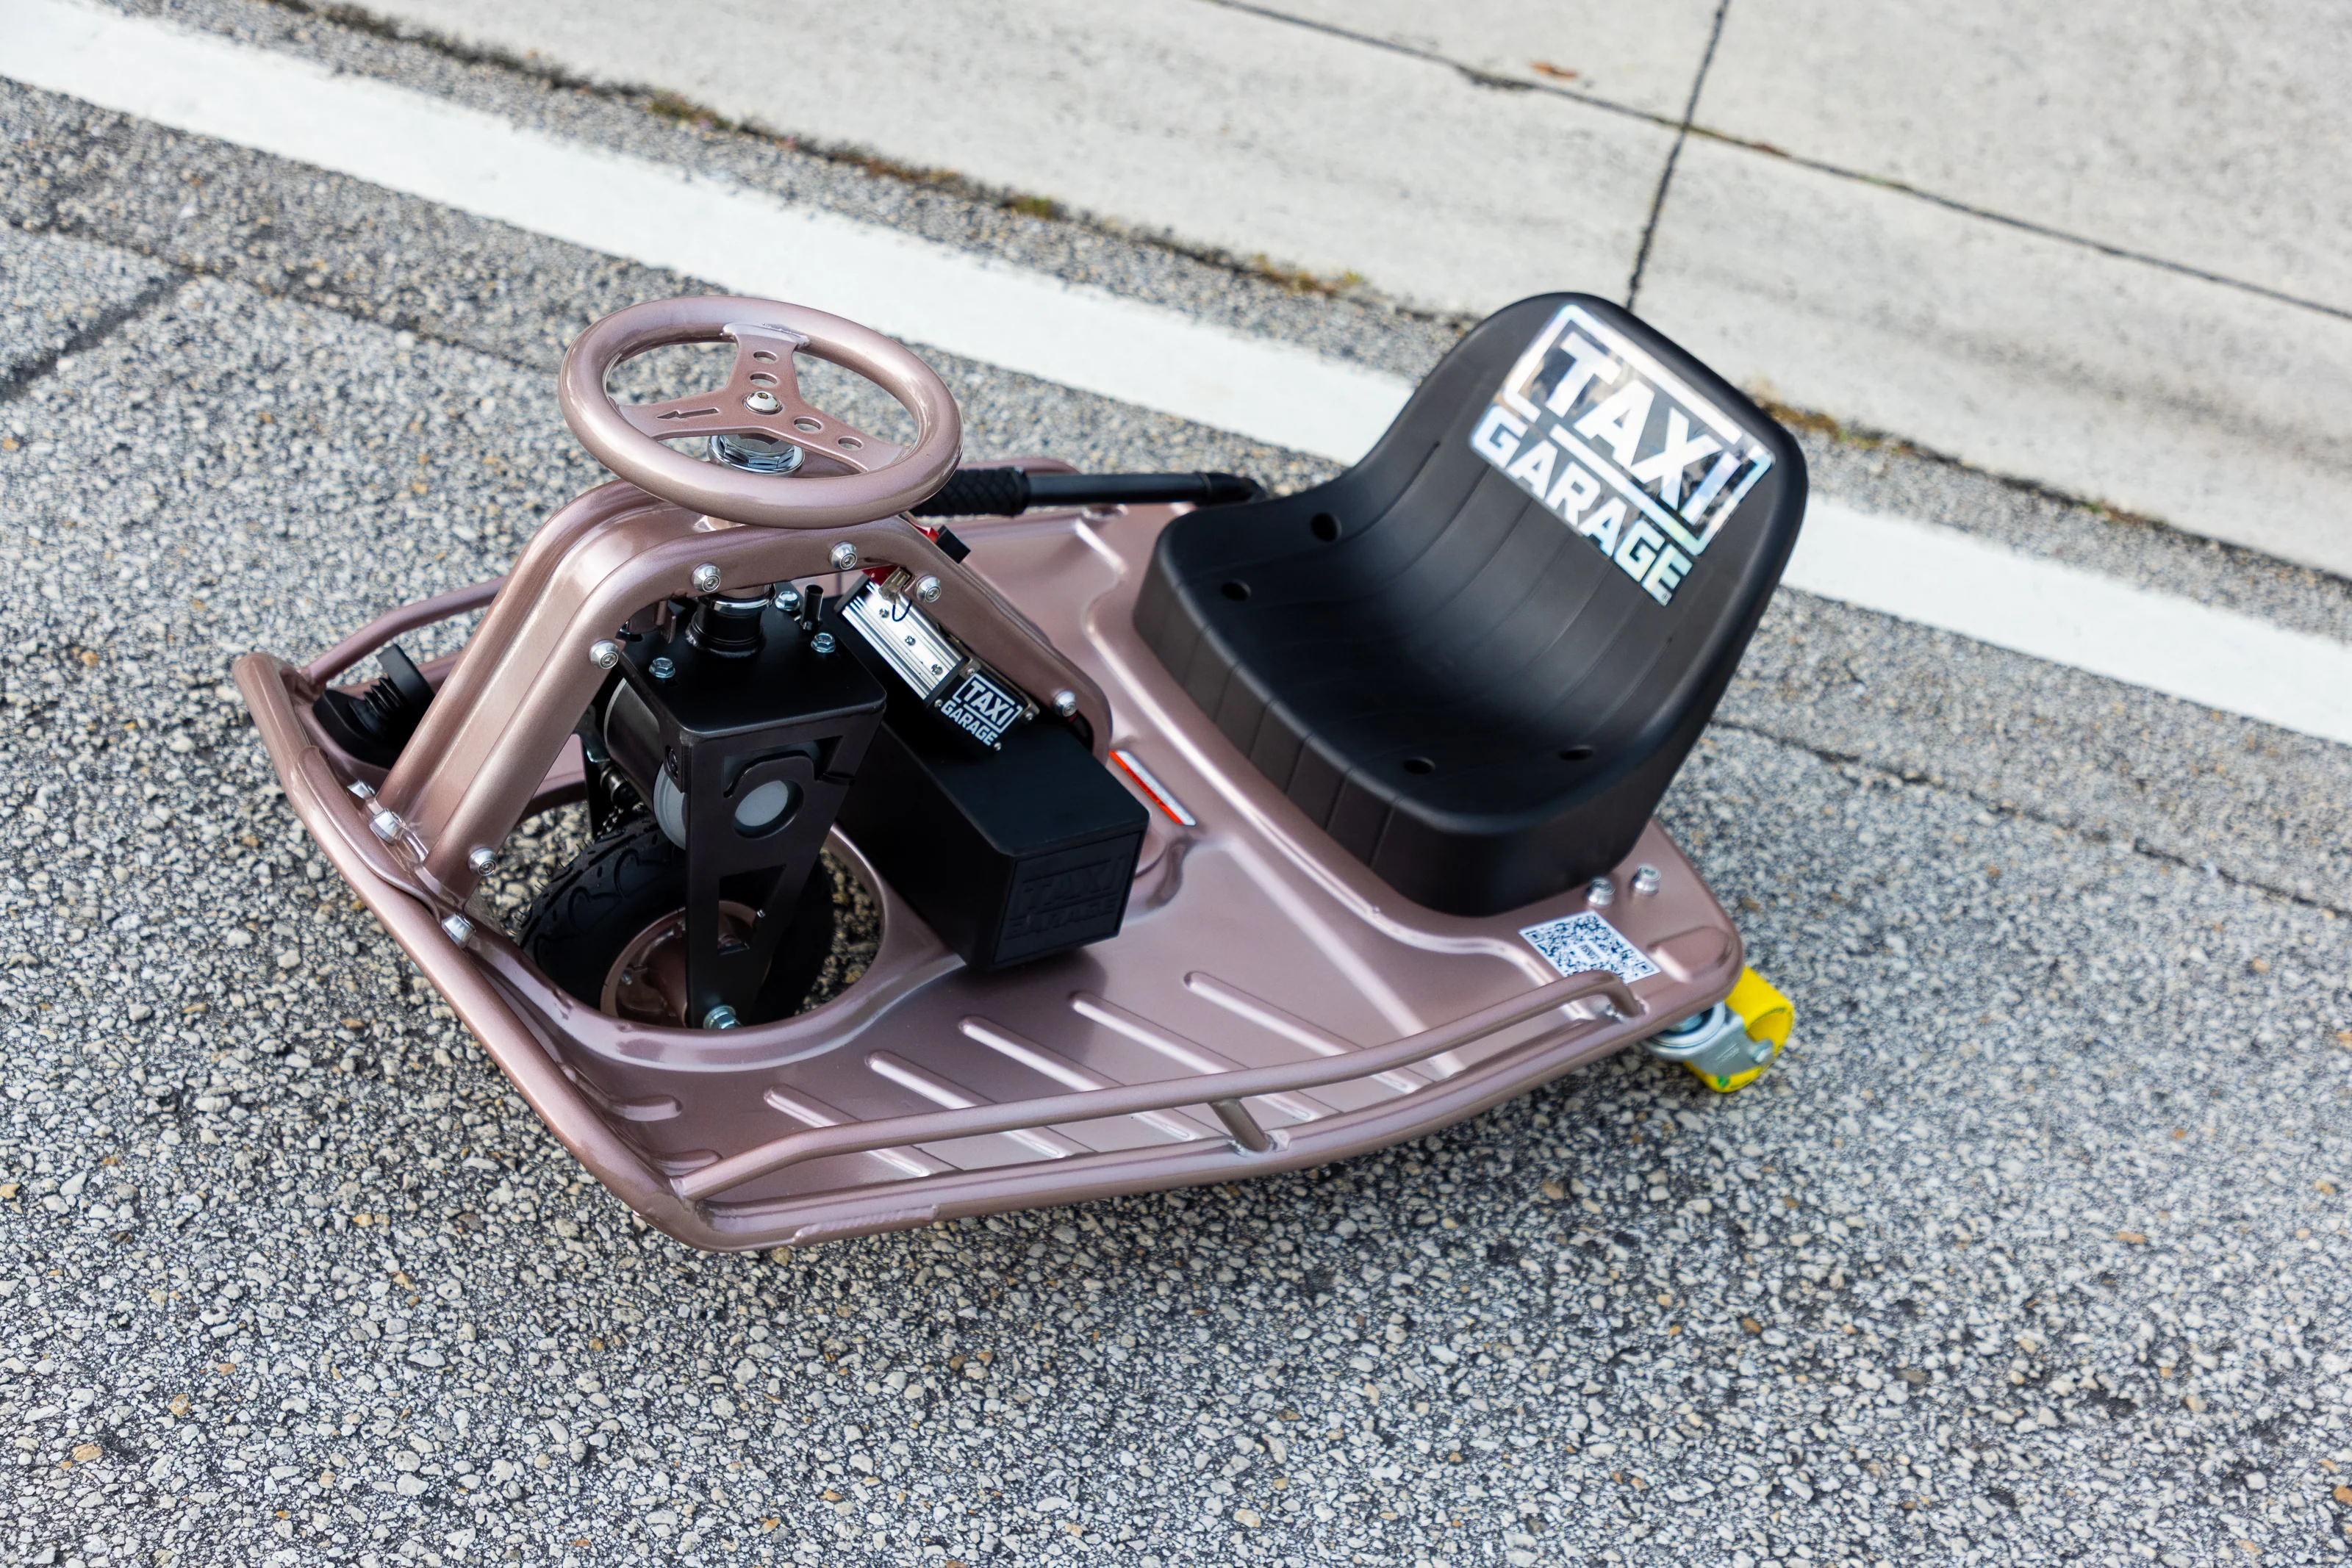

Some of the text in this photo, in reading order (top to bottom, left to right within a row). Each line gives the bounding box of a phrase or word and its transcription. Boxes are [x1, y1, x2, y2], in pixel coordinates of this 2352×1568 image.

[1546, 331, 1741, 526] TAXI
[1471, 405, 1693, 606] GARAGE
[941, 700, 998, 747] GARAGE
[964, 680, 1014, 726] TAXI
